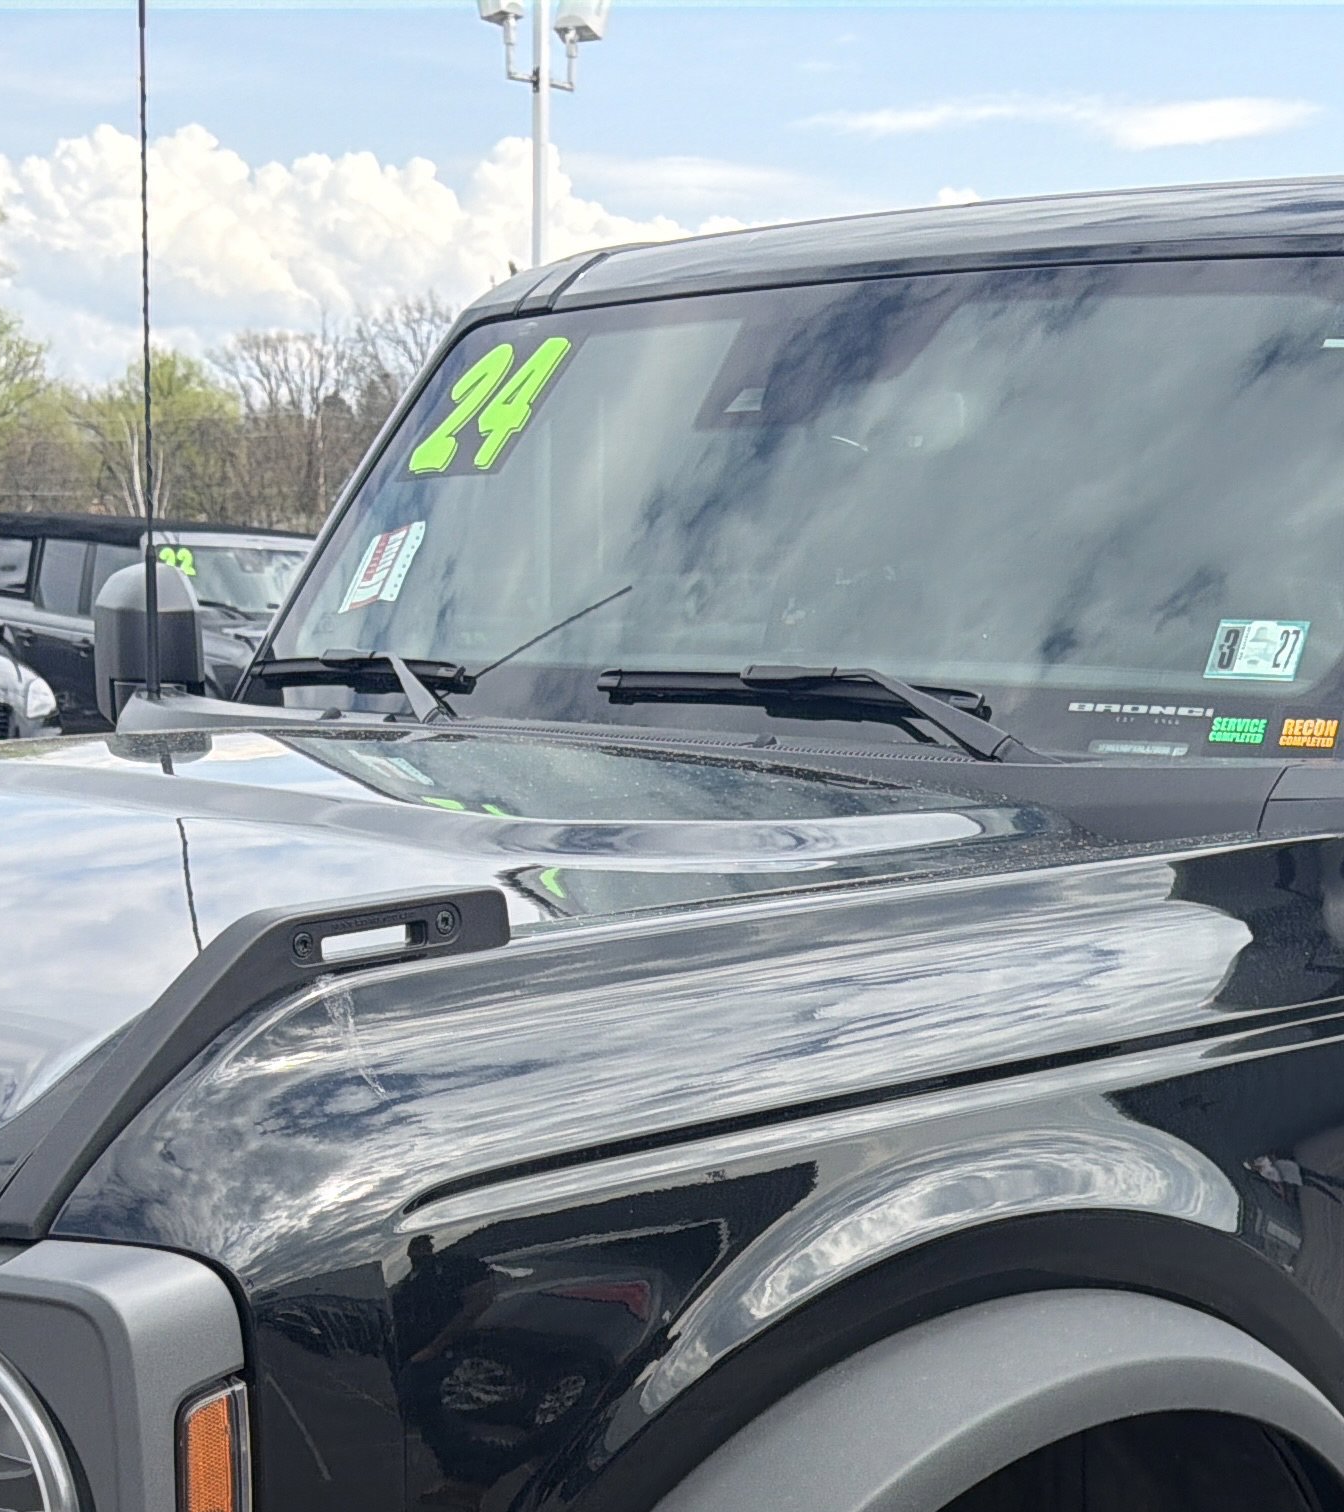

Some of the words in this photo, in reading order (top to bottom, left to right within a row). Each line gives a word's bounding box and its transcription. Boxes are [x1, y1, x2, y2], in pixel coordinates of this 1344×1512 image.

[408, 337, 572, 474] 24
[159, 547, 196, 576] 22
[1217, 628, 1240, 670] 3
[1272, 629, 1301, 672] 27
[1068, 702, 1214, 718] BRONC
[1211, 716, 1268, 733] SERVICE
[1282, 718, 1339, 737] RECON
[1208, 732, 1265, 745] COMPLETED
[1279, 735, 1334, 749] COMPLETED
